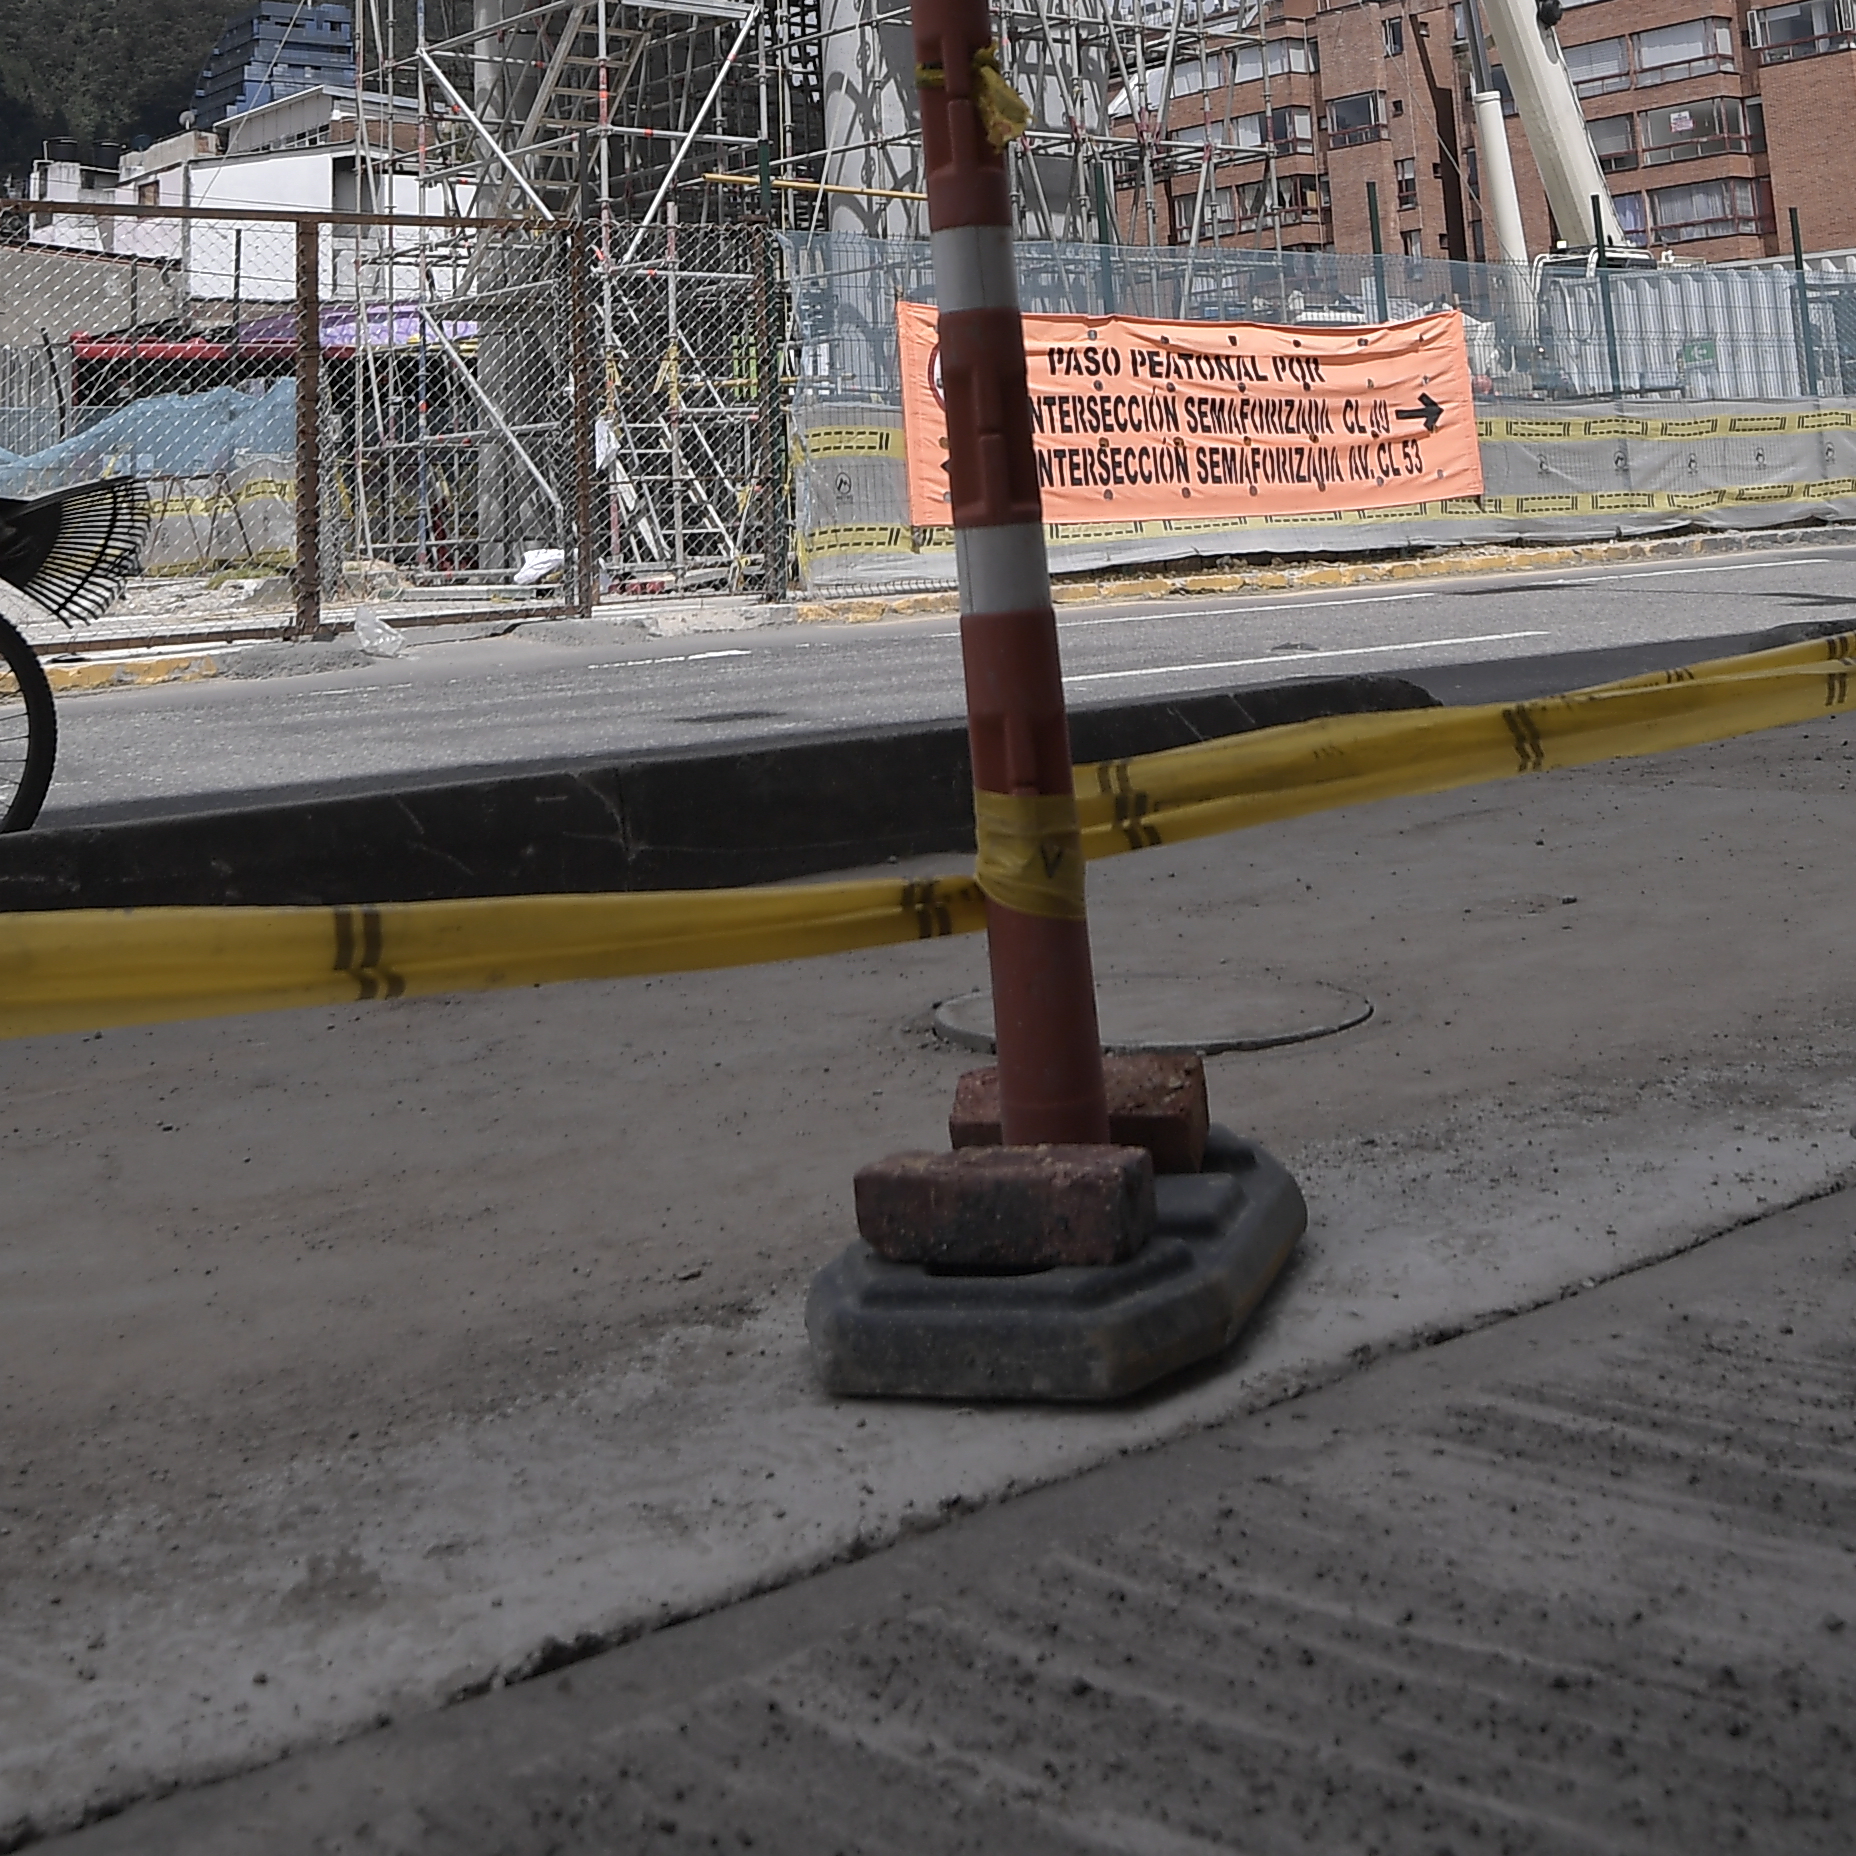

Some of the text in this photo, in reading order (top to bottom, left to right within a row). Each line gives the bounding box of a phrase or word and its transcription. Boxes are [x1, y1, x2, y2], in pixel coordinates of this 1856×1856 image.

[1048, 347, 1325, 382] PASO PEATONAL POR
[1029, 385, 1180, 434] NTERSECCIÓN
[1184, 395, 1335, 434] SEMAFORIZADA
[1343, 399, 1367, 434] CL
[1037, 437, 1423, 487] NTERSECCIÓN SEMAFORIZADA AV. CL 53
